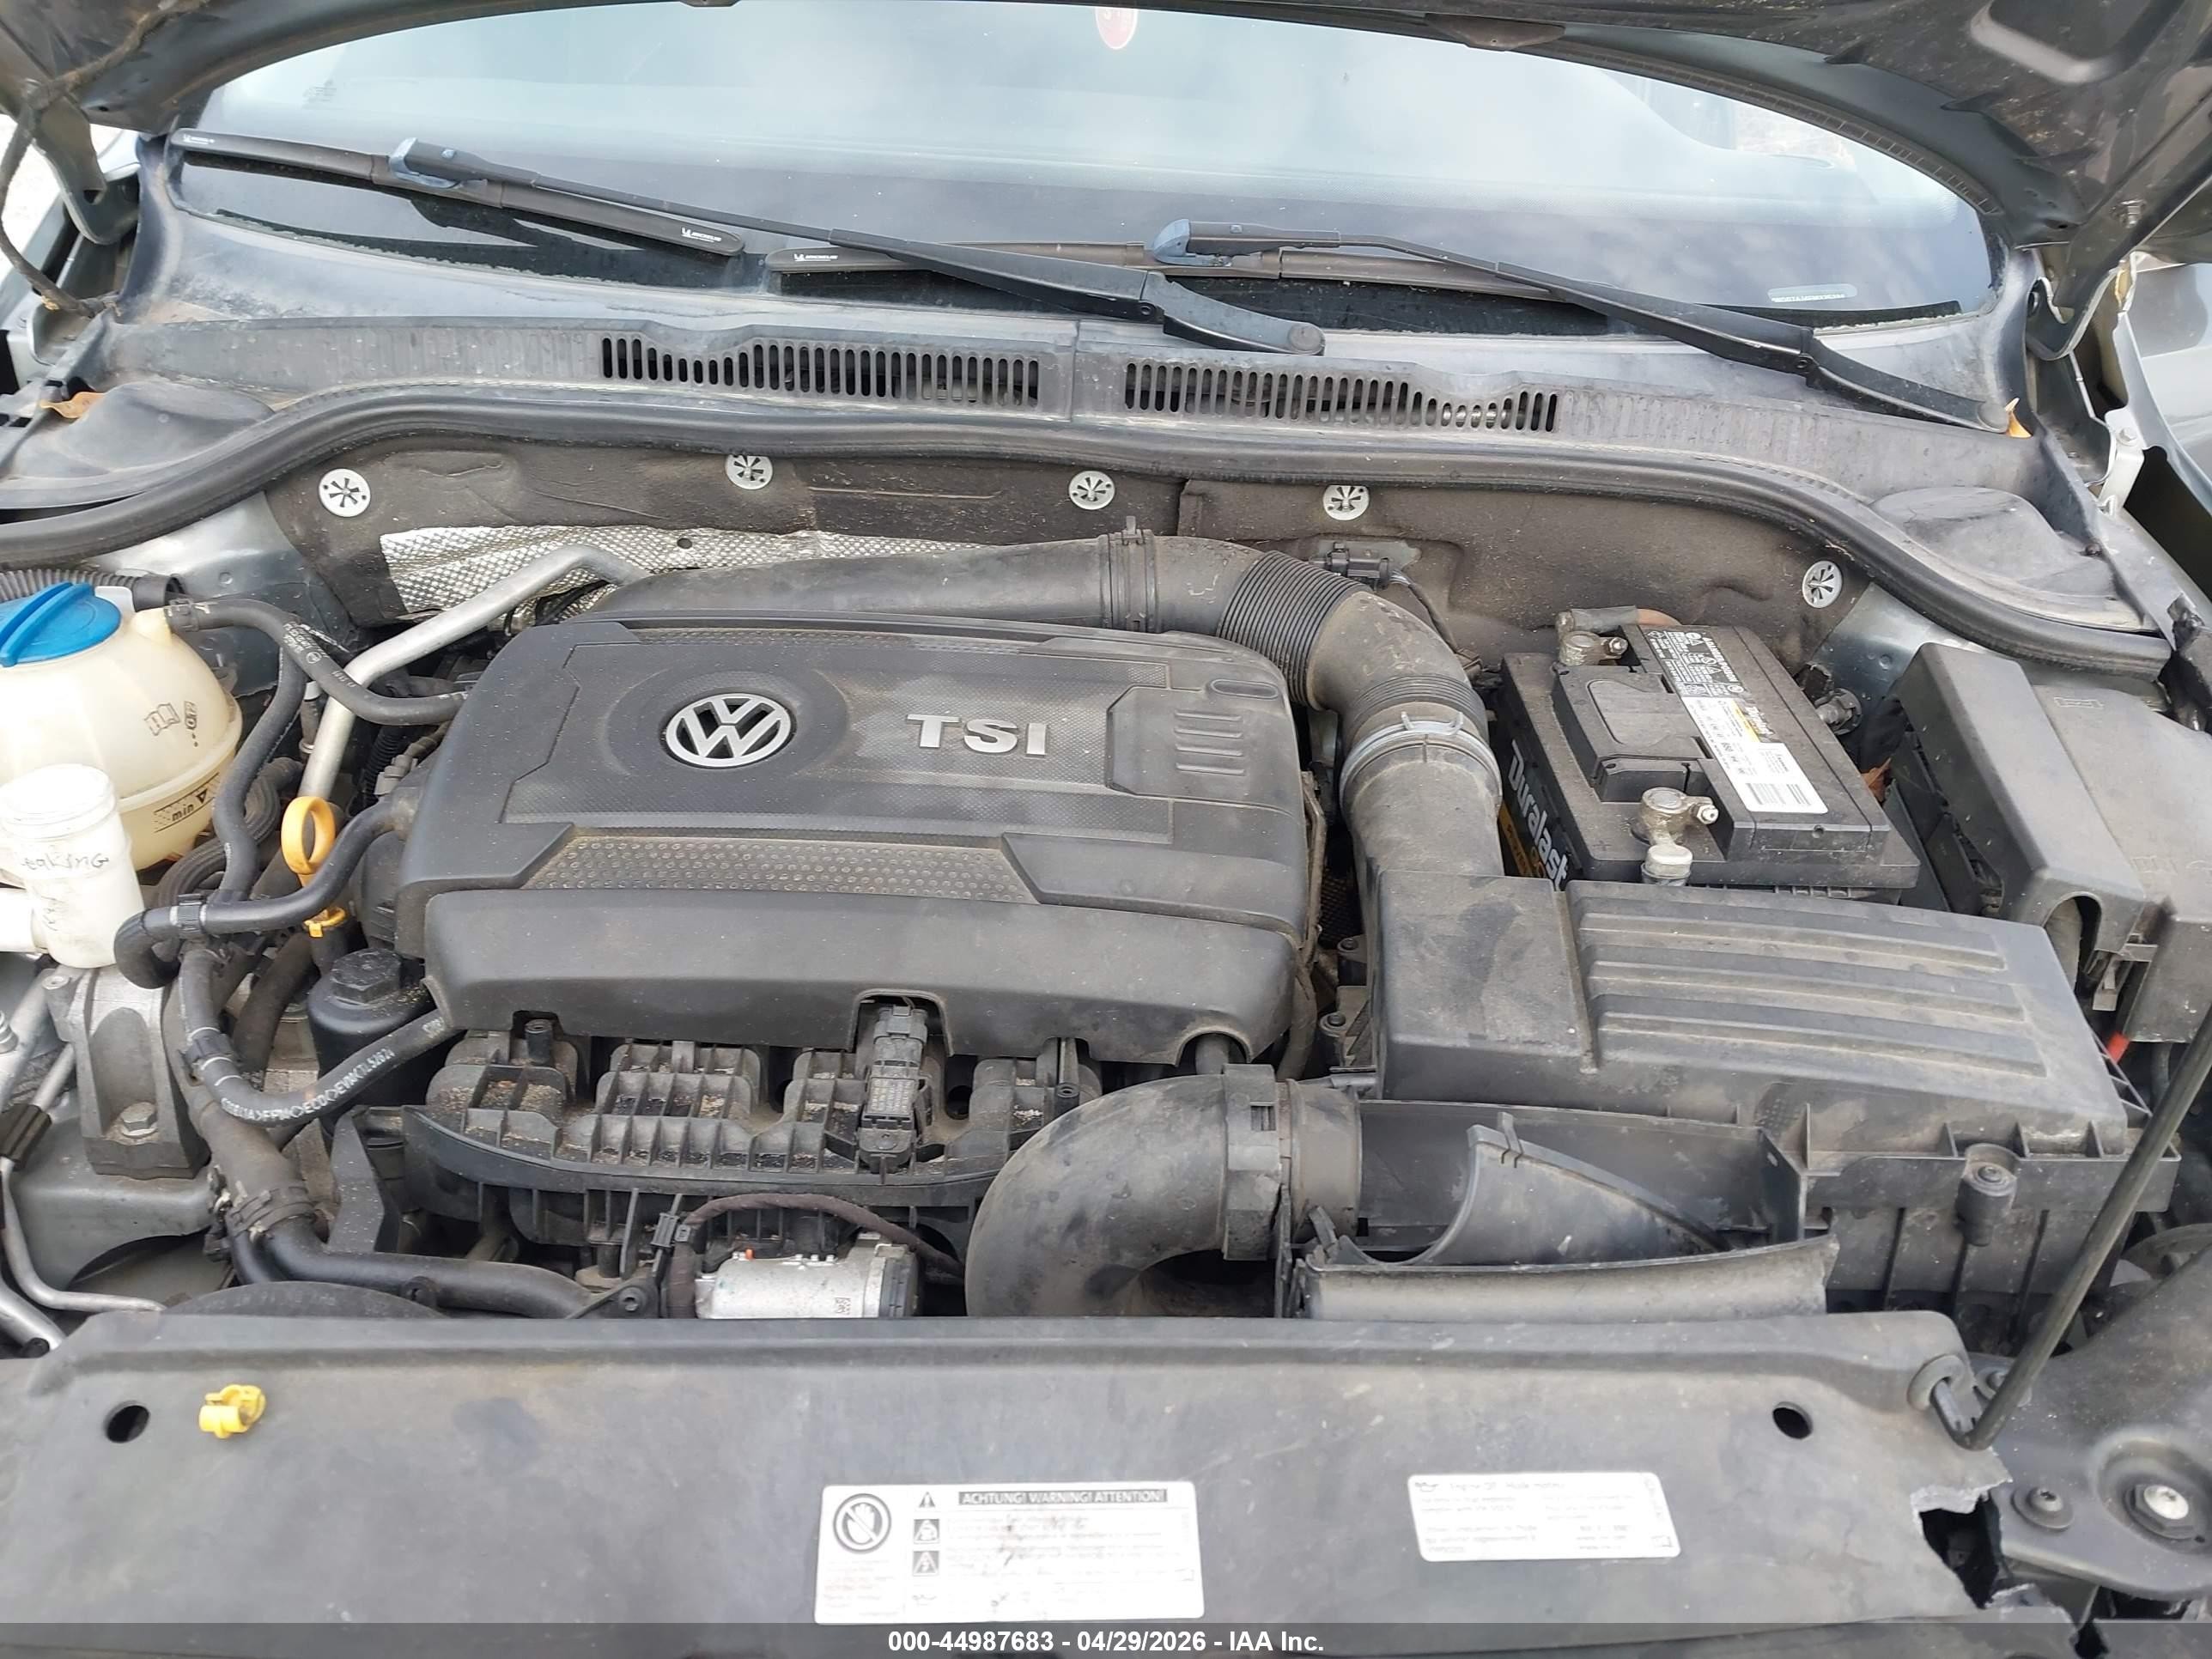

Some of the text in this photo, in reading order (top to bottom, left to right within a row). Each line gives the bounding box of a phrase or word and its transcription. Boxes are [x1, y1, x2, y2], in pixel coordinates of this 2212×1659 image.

[665, 693, 792, 768] VW
[907, 714, 1049, 757] TSI
[172, 803, 195, 822] min
[1509, 739, 1568, 892] Duralast
[962, 1489, 1165, 1504] ACHTUNG! WARNING! ATTENTION!
